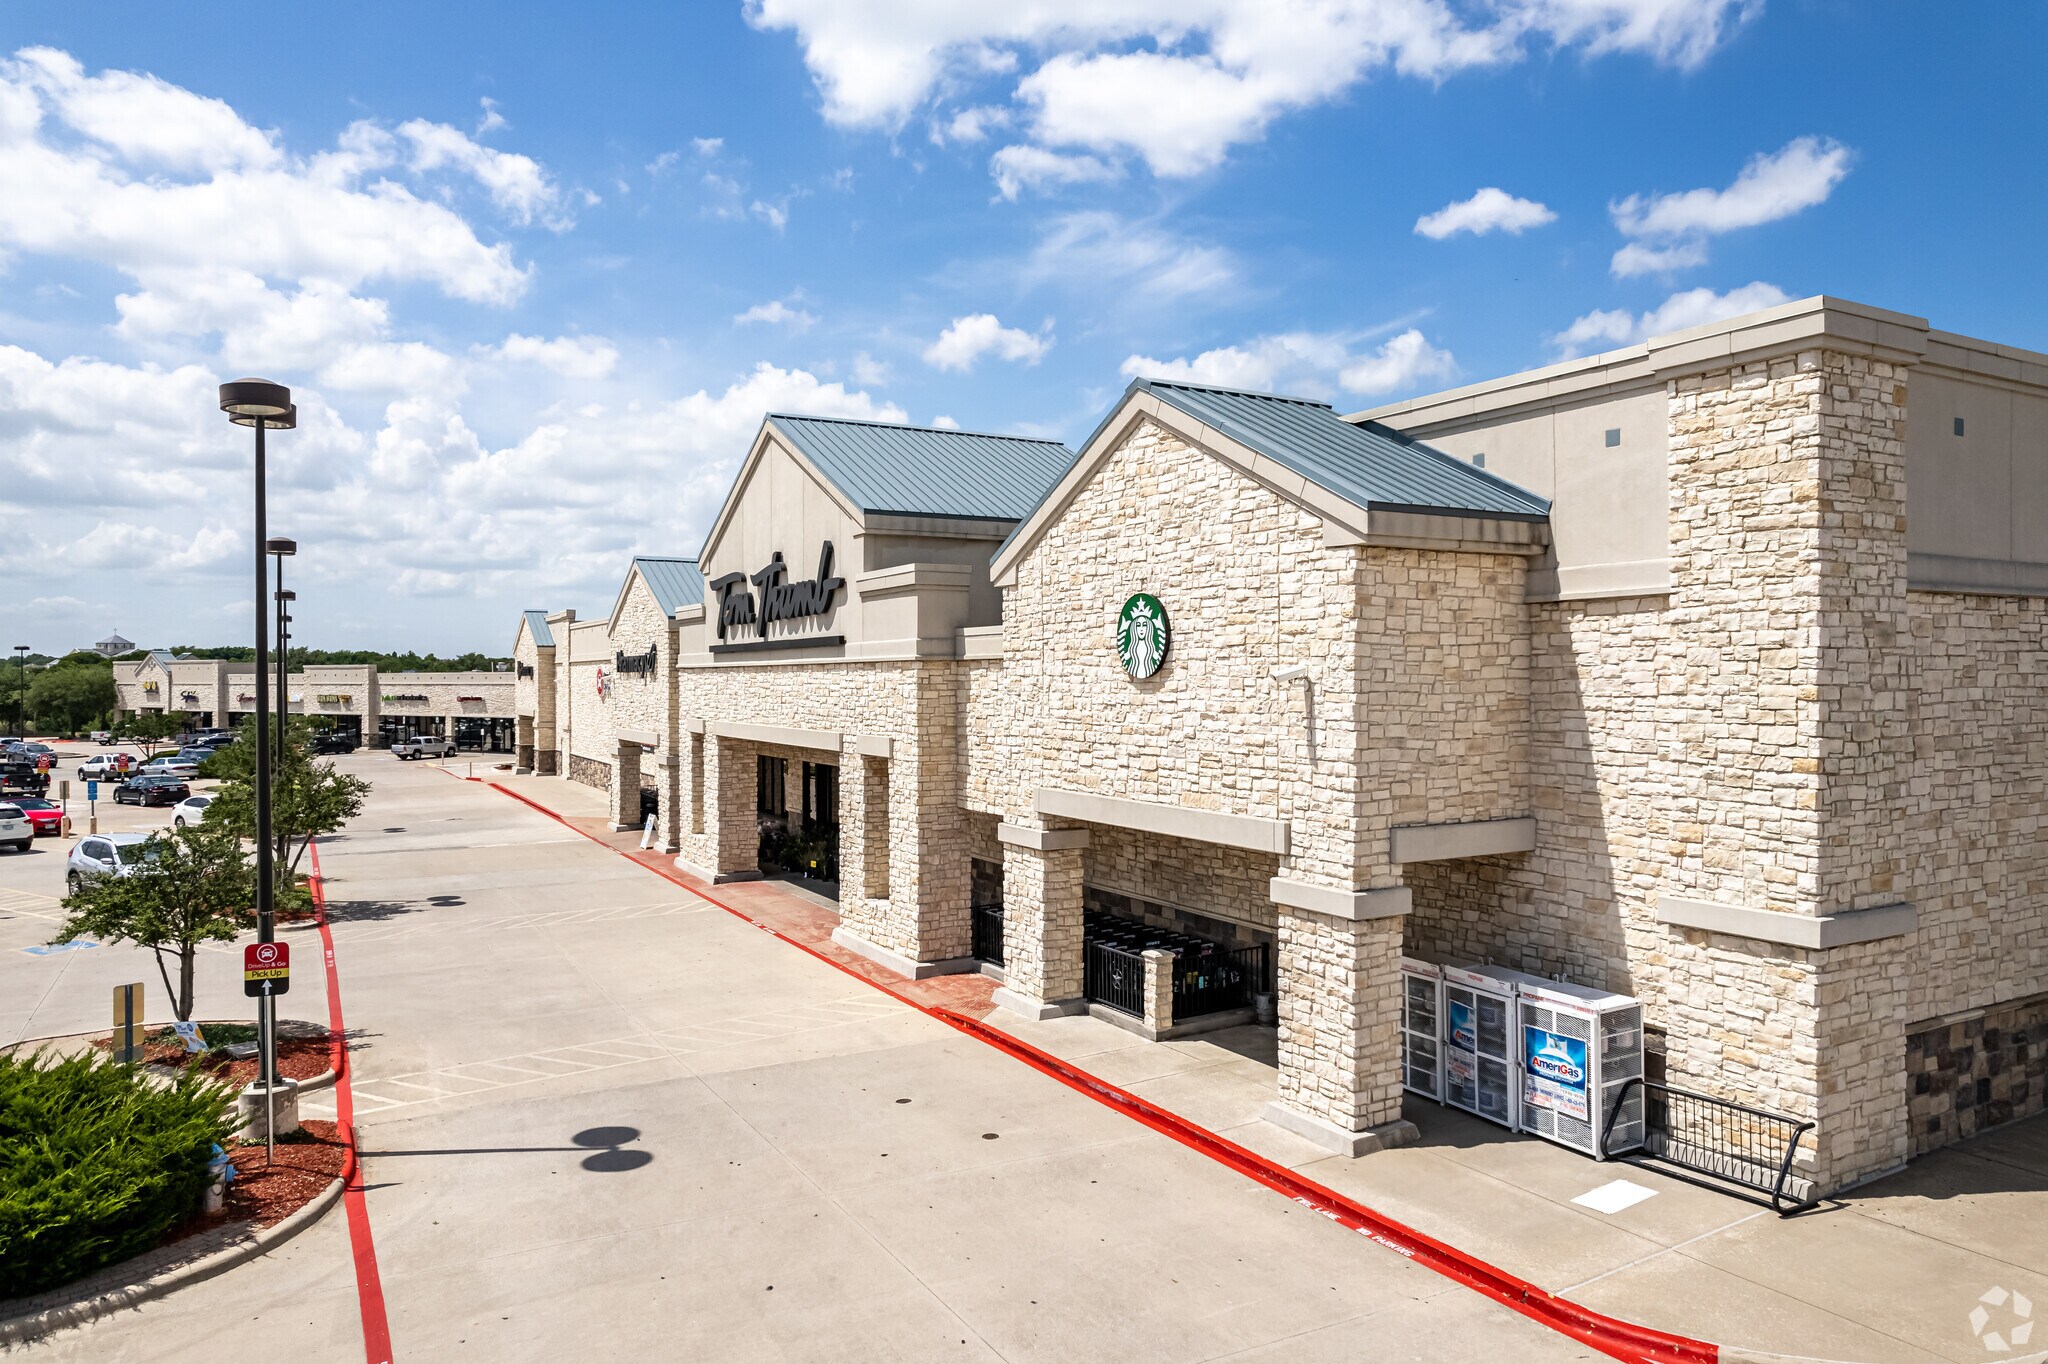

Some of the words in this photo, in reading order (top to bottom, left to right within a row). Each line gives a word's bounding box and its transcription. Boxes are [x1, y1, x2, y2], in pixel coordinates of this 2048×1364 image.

[709, 571, 757, 640] Tom
[750, 540, 846, 638] Thumb
[251, 970, 269, 978] Pick
[270, 969, 283, 977] Up
[1532, 1056, 1580, 1079] AmeriGas
[1292, 1196, 1316, 1208] FIRE
[1314, 1207, 1342, 1221] LANE
[1355, 1227, 1373, 1236] NO
[1371, 1235, 1415, 1257] PARKING
